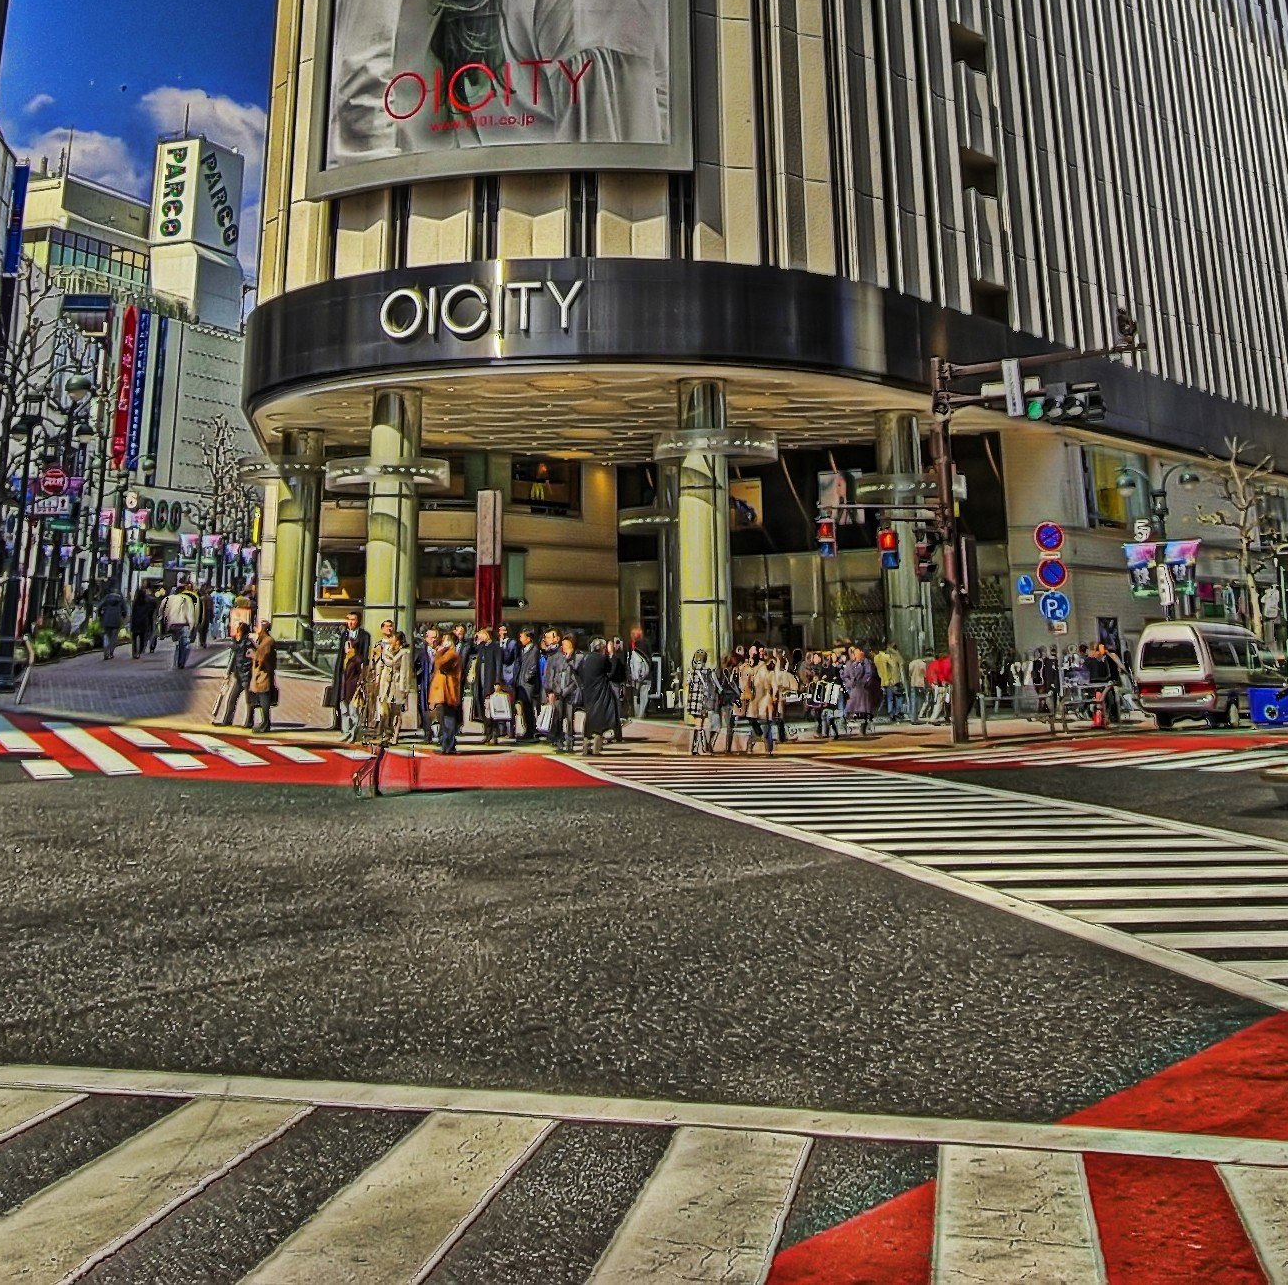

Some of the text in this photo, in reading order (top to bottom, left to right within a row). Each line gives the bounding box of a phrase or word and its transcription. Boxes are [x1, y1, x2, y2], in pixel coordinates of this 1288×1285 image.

[159, 146, 189, 237] PARCO
[200, 152, 240, 247] PARCO
[1047, 598, 1058, 618] P
